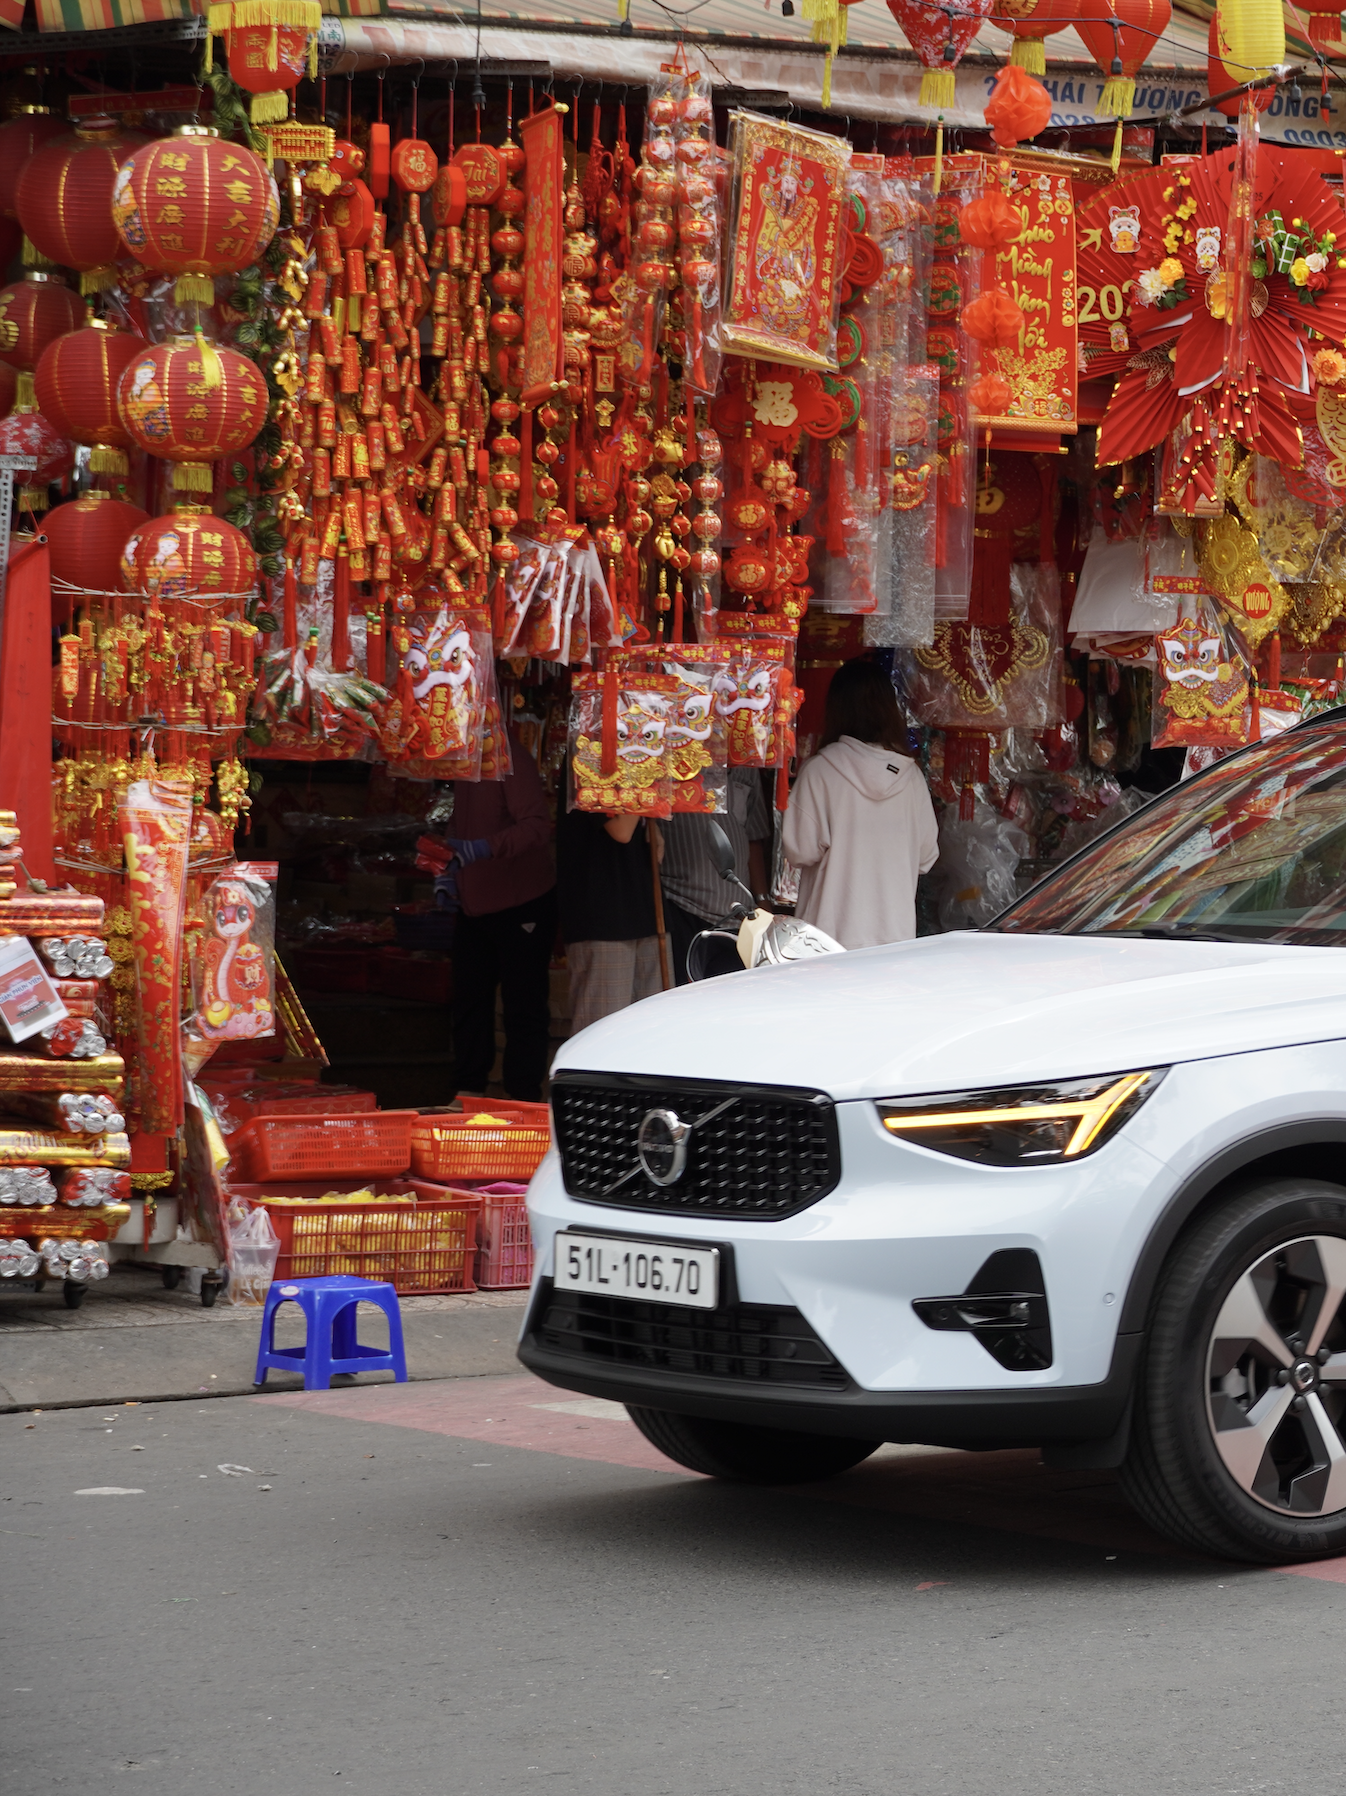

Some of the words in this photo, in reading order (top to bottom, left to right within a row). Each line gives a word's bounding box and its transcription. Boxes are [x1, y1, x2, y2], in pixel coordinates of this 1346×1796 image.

[1043, 76, 1085, 104] HẢI
[1096, 80, 1202, 115] TƯỢNG
[462, 159, 488, 183] Tài
[1006, 204, 1056, 244] húc
[752, 381, 799, 428] 福
[568, 1245, 700, 1296] 51L-106.70
